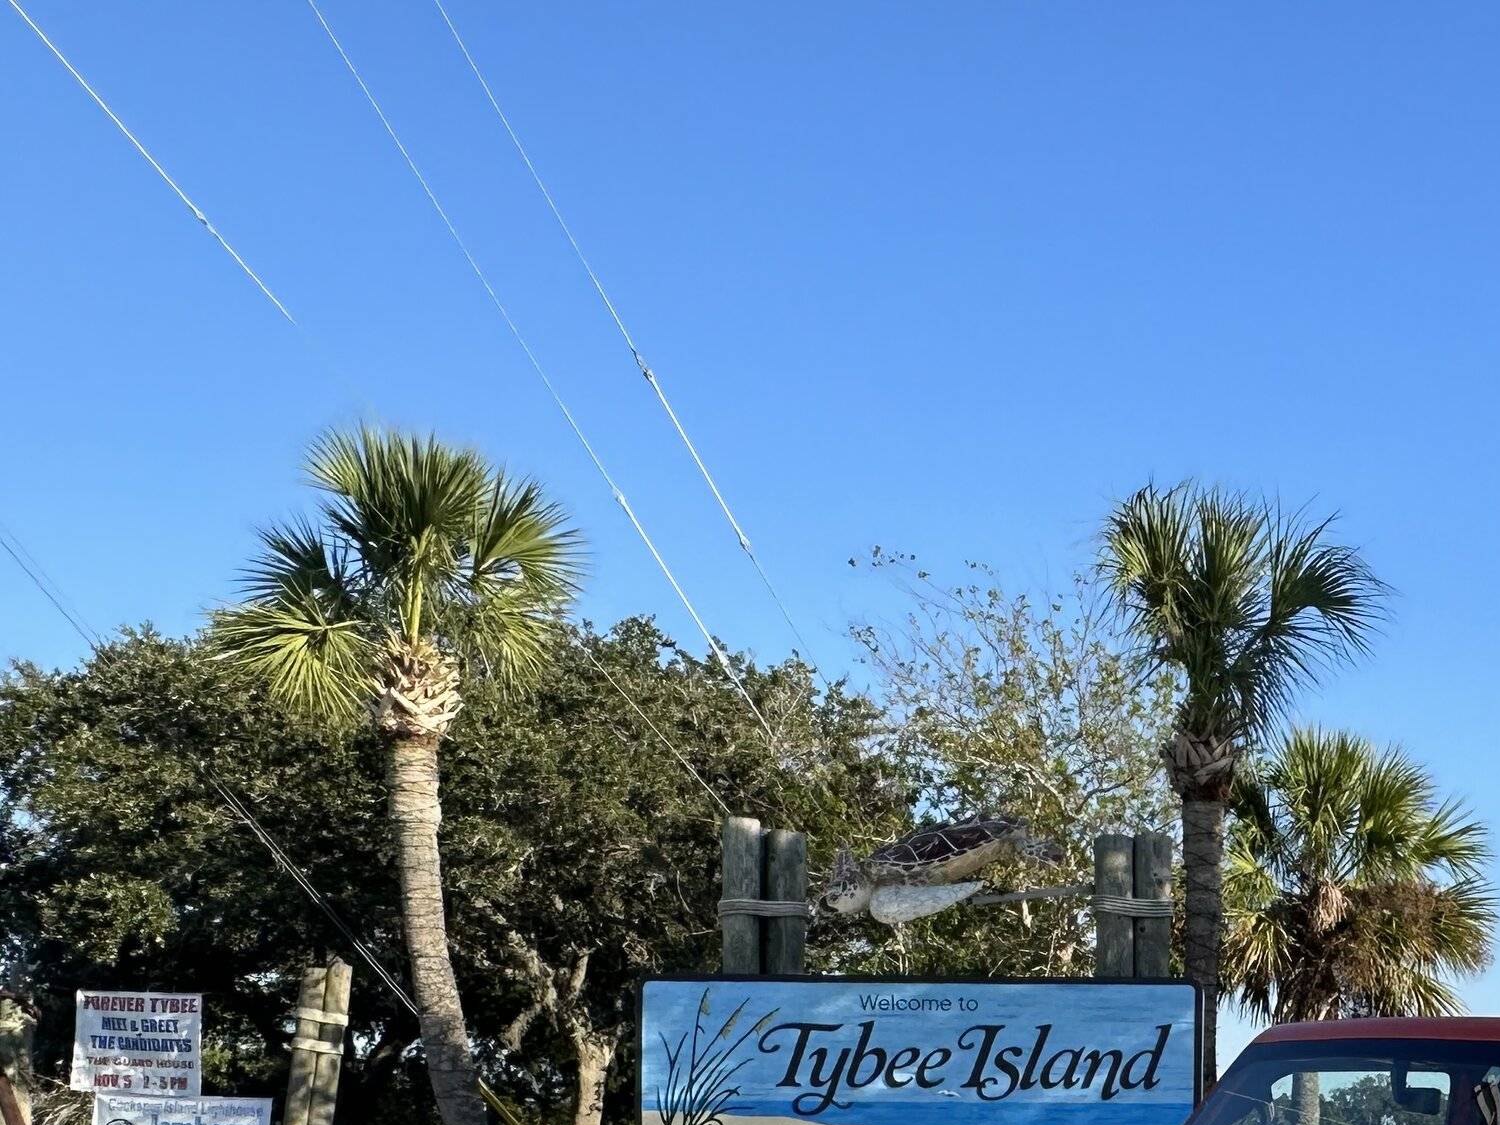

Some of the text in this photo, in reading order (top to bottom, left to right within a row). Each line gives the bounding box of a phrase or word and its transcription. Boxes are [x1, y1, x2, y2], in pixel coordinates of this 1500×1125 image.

[84, 996, 198, 1014] FOREVER TYBEE
[859, 994, 979, 1012] Welcome to
[102, 1017, 128, 1032] MEET
[140, 1018, 179, 1034] GREET
[90, 1034, 192, 1053] THE CANDIDATES
[758, 1020, 1173, 1116] Tybee Island
